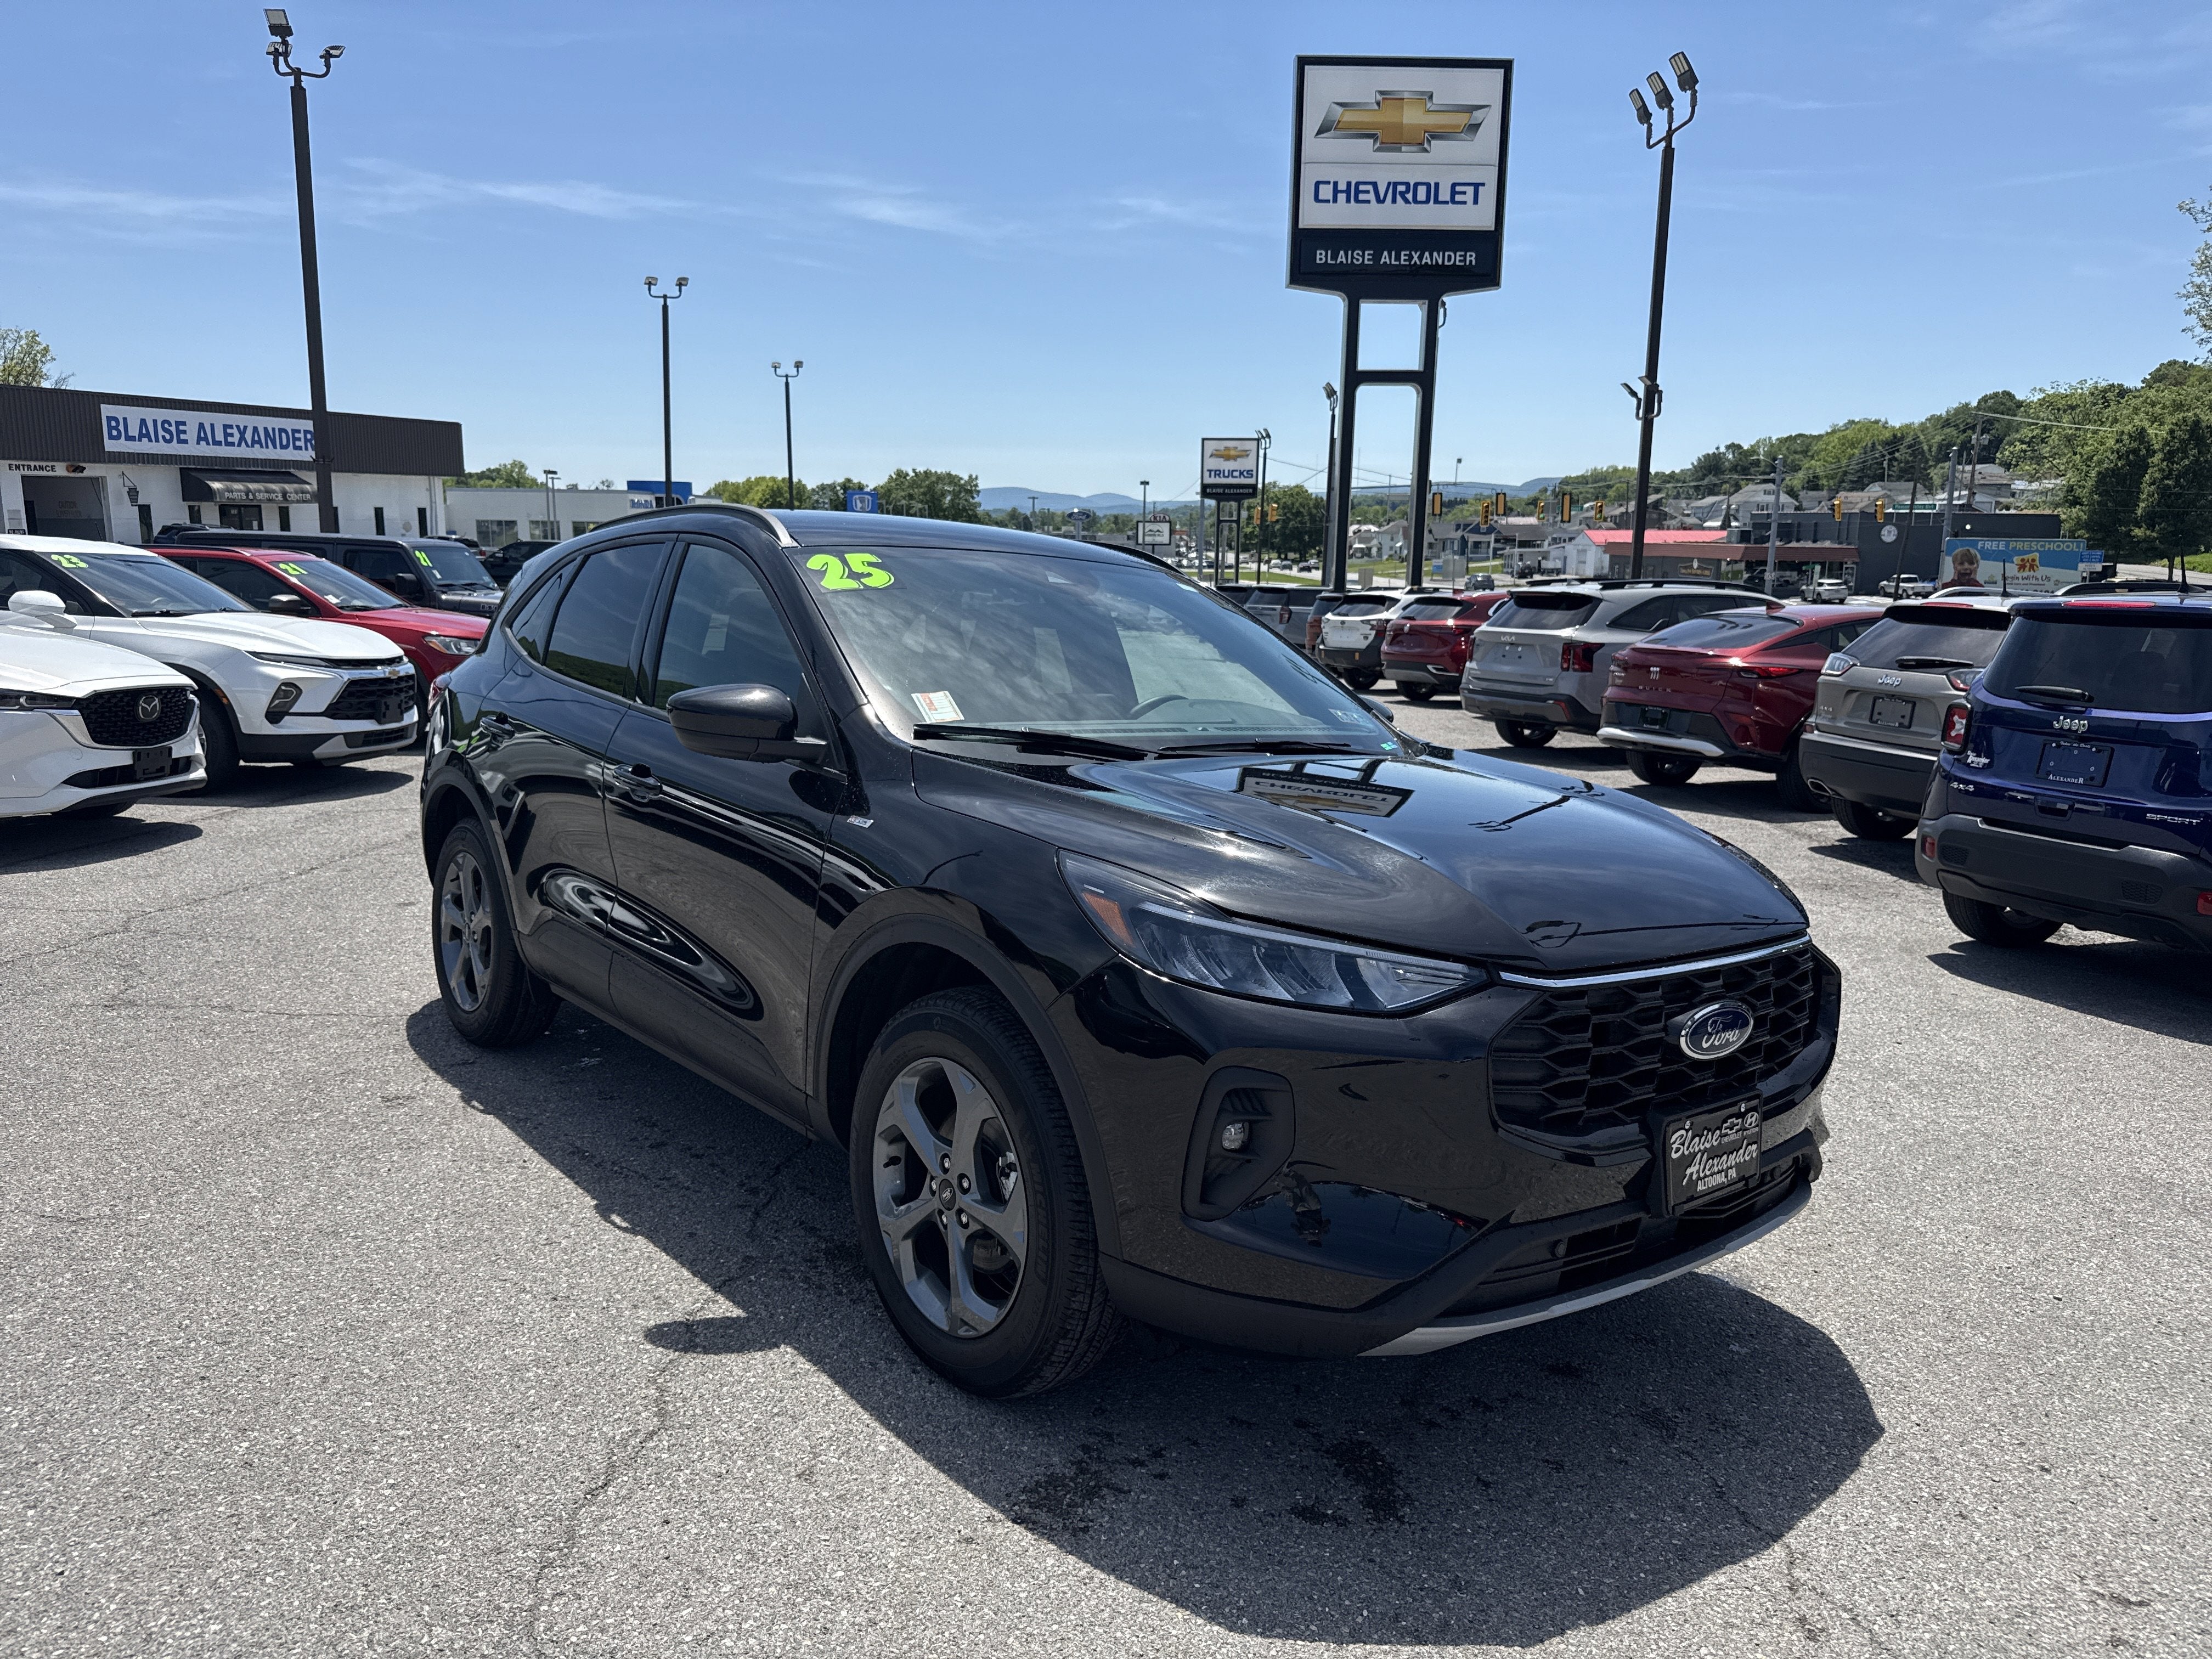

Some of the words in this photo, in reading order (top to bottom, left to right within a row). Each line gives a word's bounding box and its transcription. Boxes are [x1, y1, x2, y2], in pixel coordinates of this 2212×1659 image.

[1313, 180, 1486, 205] CHEVROLET
[1316, 250, 1374, 265] BLAISE
[1380, 250, 1476, 266] ALEXANDER
[105, 415, 189, 445] BLAISE
[196, 422, 315, 452] ALEXANDER
[8, 463, 57, 472] ENTRANCE
[1206, 469, 1254, 479] TRUCKS
[224, 492, 246, 500] PARTS
[248, 492, 254, 500] &
[256, 493, 283, 501] SERVICE
[1978, 541, 2006, 550] FREE
[2009, 541, 2084, 551] PRESCHOOL!
[51, 554, 89, 568] 23
[415, 550, 433, 567] 21
[279, 563, 308, 575] 21
[806, 553, 895, 590] 25
[1877, 674, 1901, 687] Jeep
[2053, 715, 2088, 733] Jeep
[2146, 813, 2201, 825] SPORT
[1702, 1015, 1742, 1048] Ford
[1670, 1129, 1722, 1159] Blaise
[1721, 1130, 1742, 1144] CHEVROLET
[1682, 1138, 1758, 1186] Alexander
[1697, 1172, 1728, 1192] ALTOONA,
[1728, 1167, 1736, 1180] PA
[1031, 1162, 1050, 1279] MICHELIN
